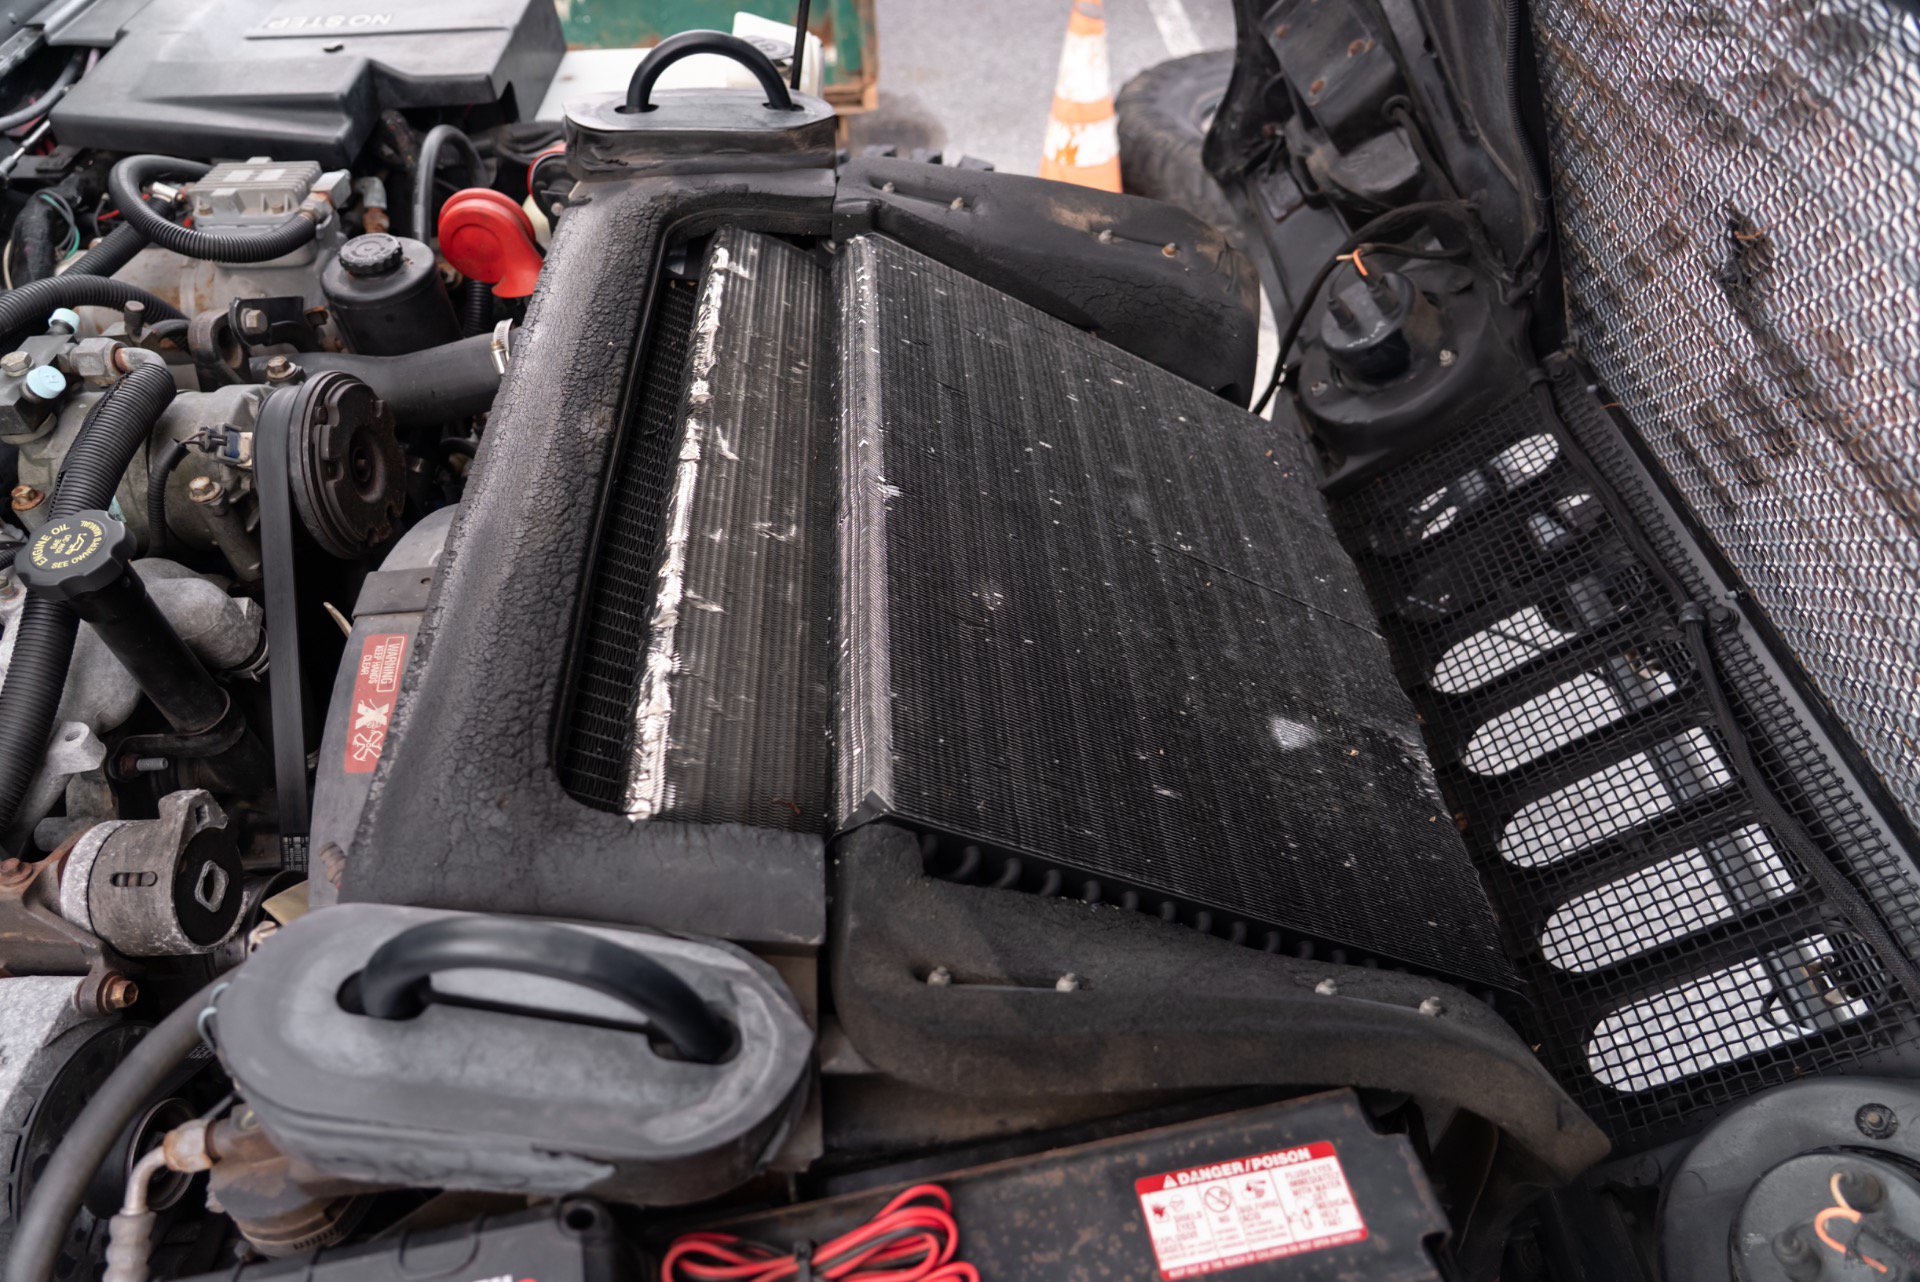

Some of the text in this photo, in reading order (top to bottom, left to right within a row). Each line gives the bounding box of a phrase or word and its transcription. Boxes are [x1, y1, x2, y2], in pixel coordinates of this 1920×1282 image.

[267, 14, 347, 29] STEP
[32, 524, 70, 566] ENGINE OIL
[51, 560, 69, 569] SEE
[361, 654, 373, 675] CLEAR
[368, 645, 385, 684] KEEP HANDS
[381, 643, 400, 685] WARNING
